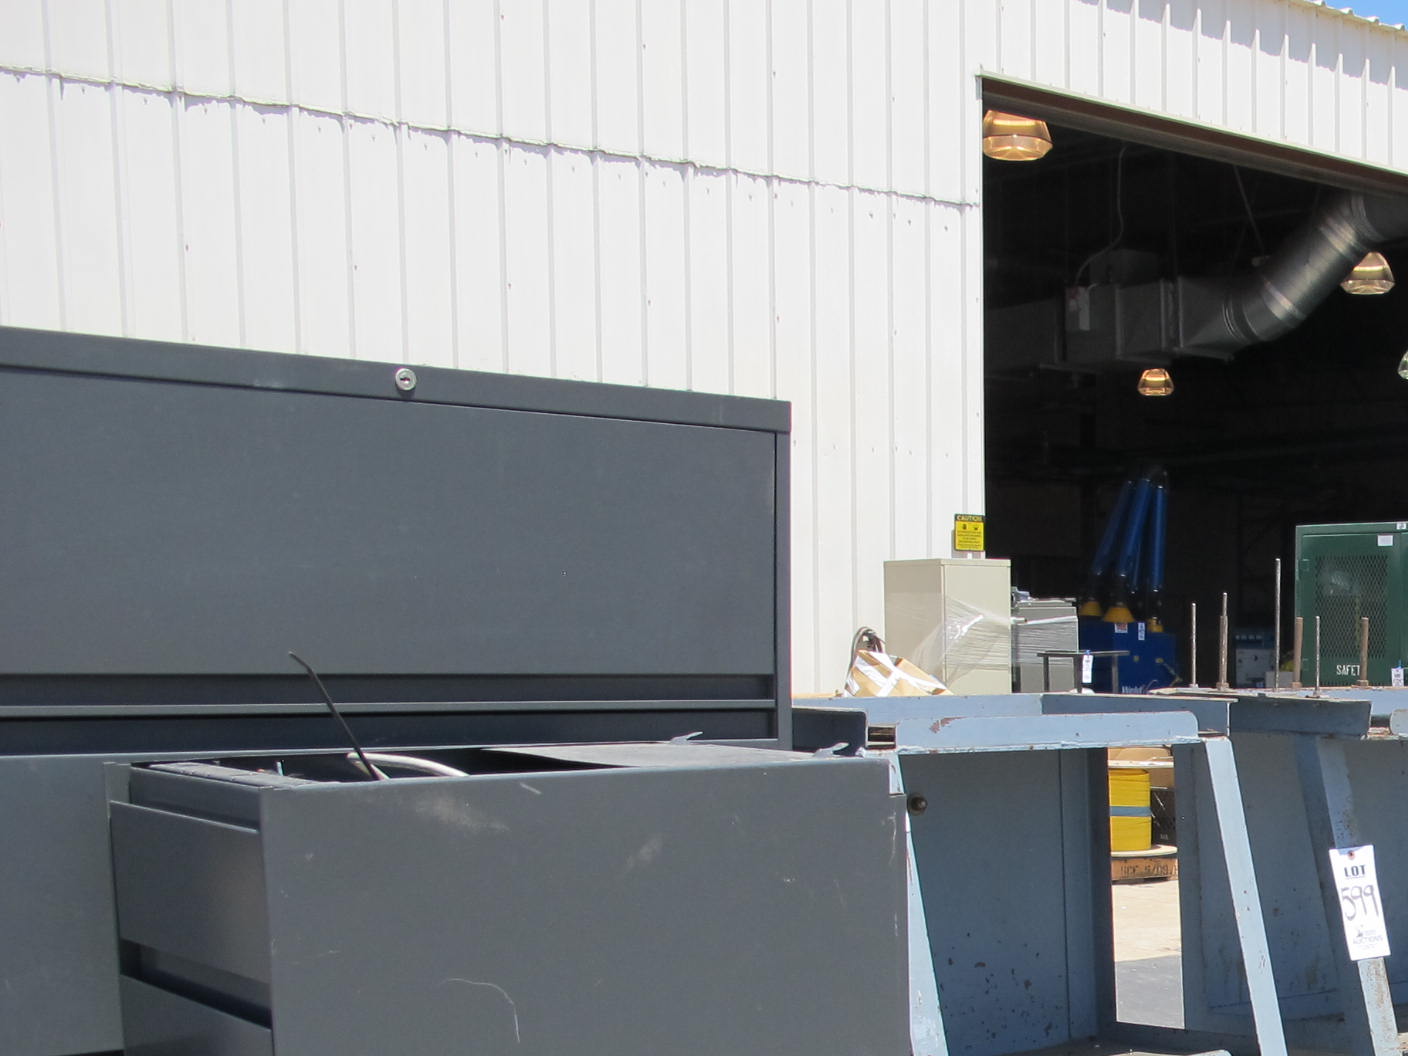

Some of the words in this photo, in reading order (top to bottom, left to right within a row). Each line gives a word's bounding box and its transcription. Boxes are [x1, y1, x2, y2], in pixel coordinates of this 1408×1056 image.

[1336, 664, 1361, 676] SAFET
[1343, 864, 1366, 877] LOT
[1340, 884, 1379, 922] 599
